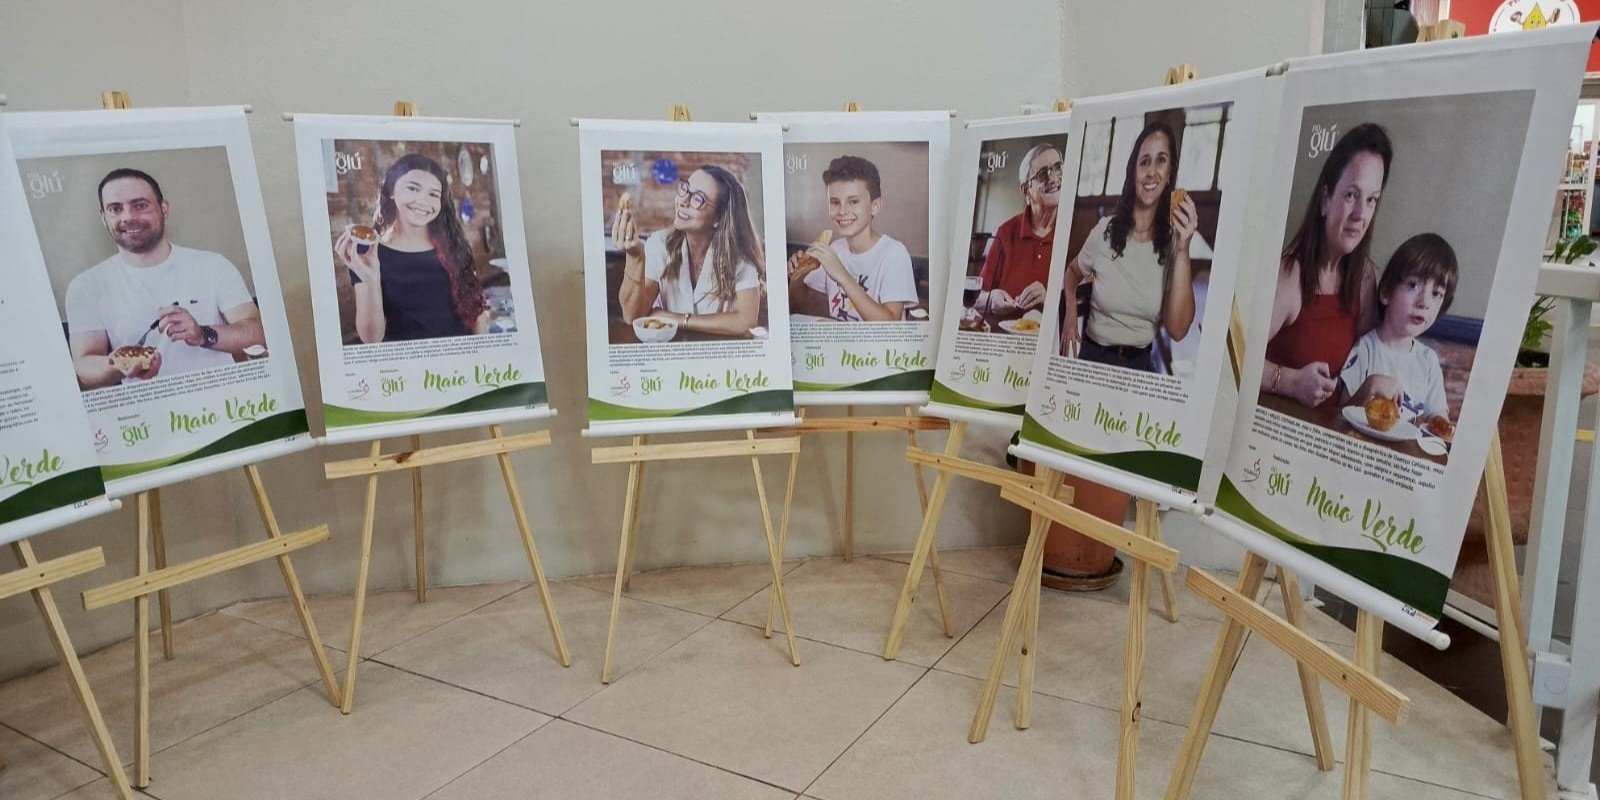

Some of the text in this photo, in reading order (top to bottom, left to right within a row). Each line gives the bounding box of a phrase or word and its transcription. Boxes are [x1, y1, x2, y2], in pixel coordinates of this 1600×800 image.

[1309, 123, 1337, 158] glú
[336, 152, 362, 174] glú
[30, 171, 64, 199] glú
[841, 349, 928, 371] Maio Verde
[424, 363, 522, 392] Maio Verde
[680, 370, 770, 394] Maio Verde
[1004, 365, 1032, 391] Mai
[170, 392, 279, 433] Maio Verde
[1094, 402, 1183, 450] Maio Verde
[1307, 477, 1425, 553] Maio Verde
